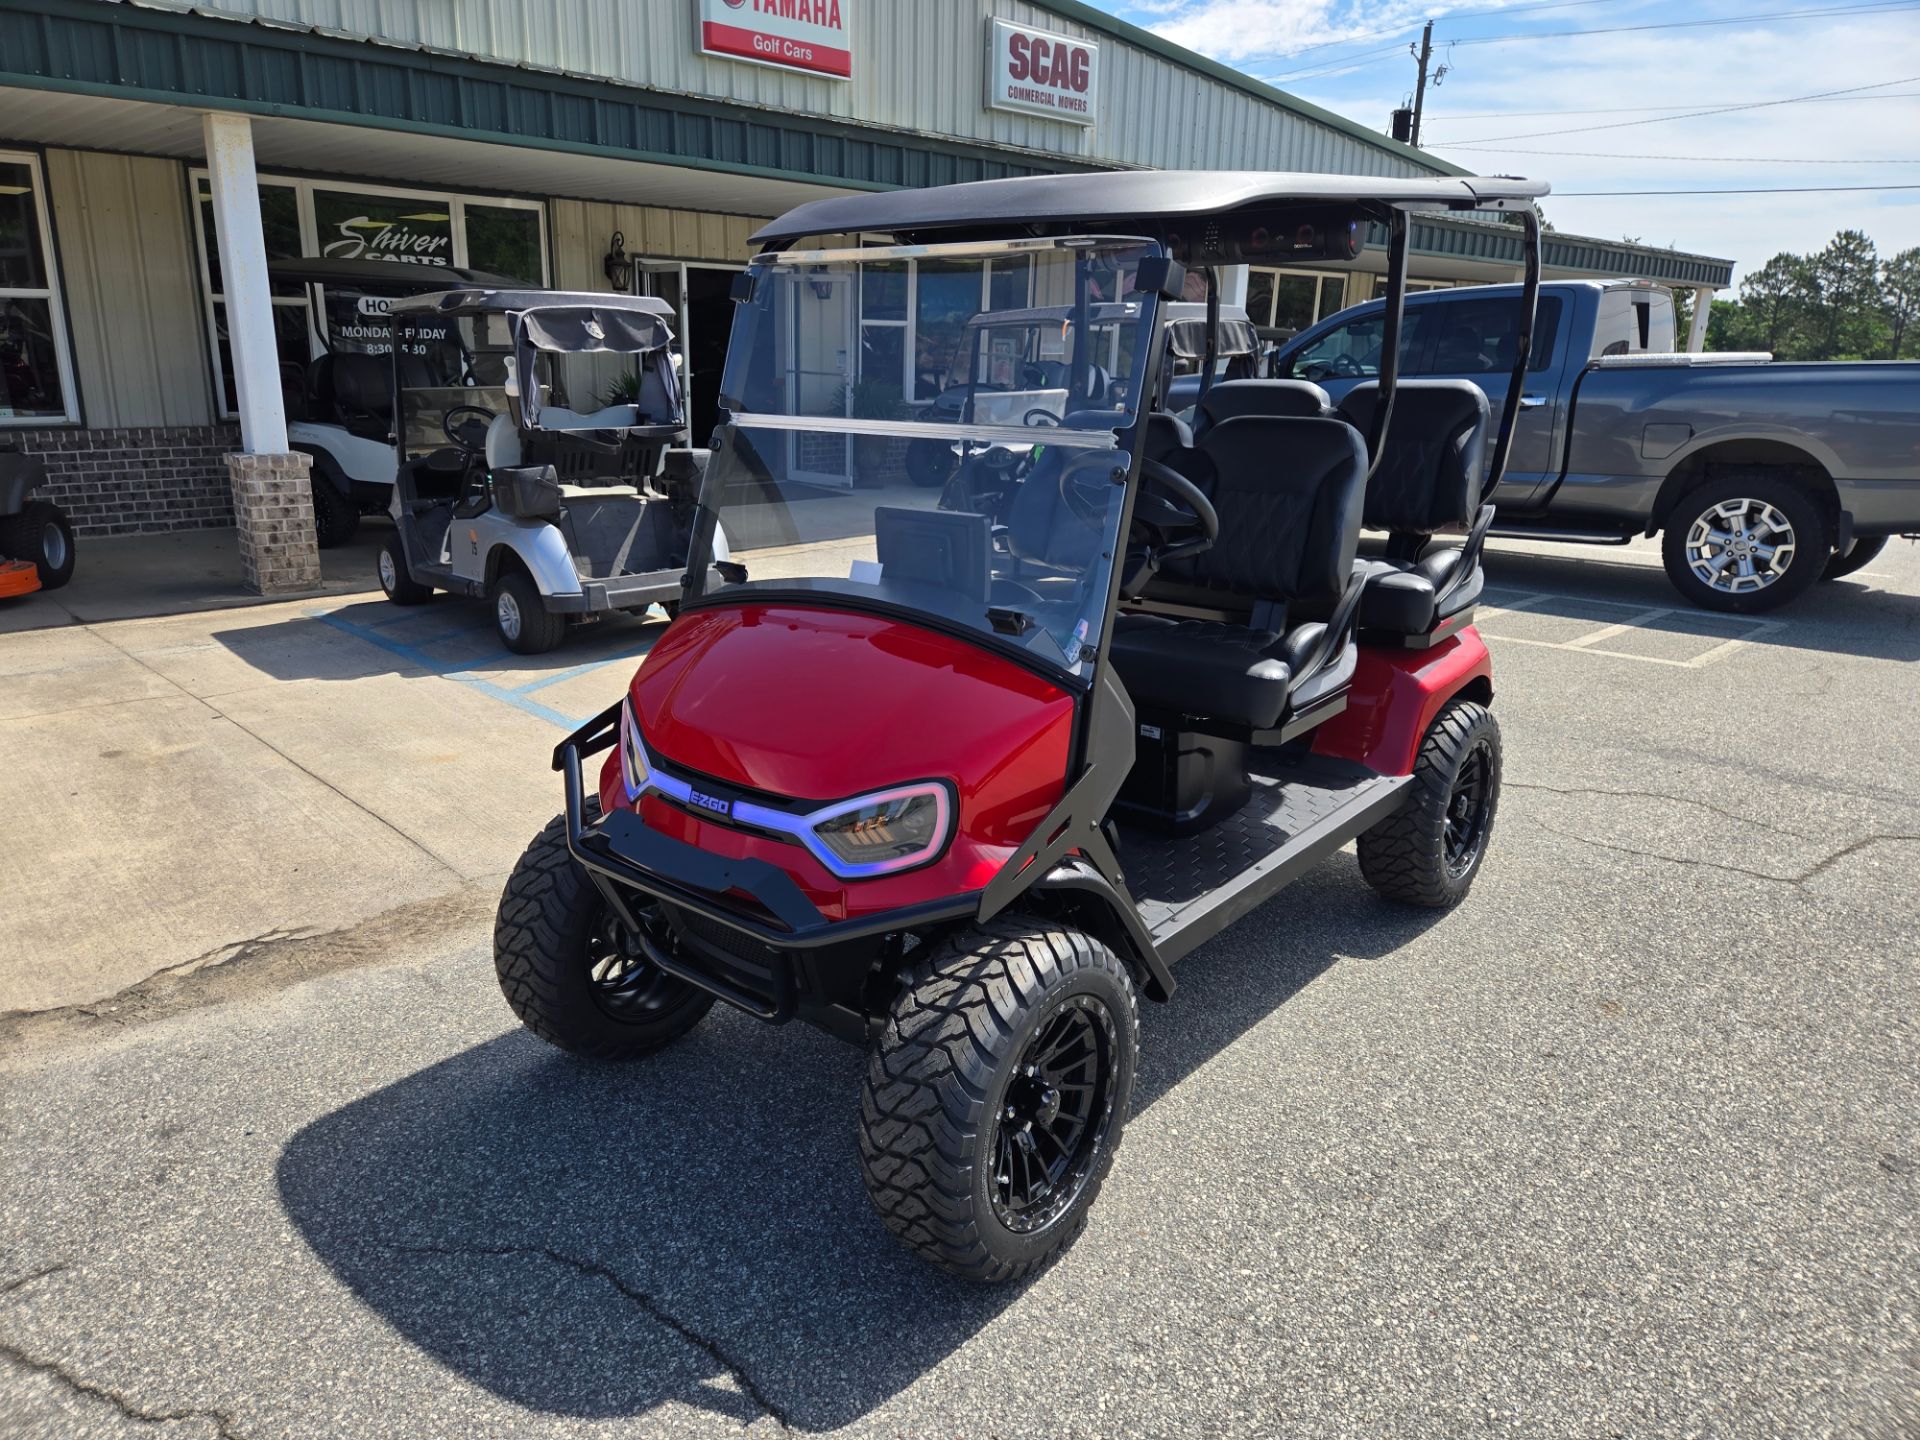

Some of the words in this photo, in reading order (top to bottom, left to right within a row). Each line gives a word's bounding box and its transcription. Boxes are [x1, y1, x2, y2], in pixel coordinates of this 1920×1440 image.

[753, 34, 780, 54] Golf
[783, 41, 813, 61] Cars
[1008, 32, 1090, 93] SCAG
[1008, 85, 1056, 107] COMMERCIAL
[1058, 95, 1088, 113] MOWERS
[324, 216, 449, 258] Shiver
[364, 252, 447, 266] CARTS
[401, 344, 427, 355] 530
